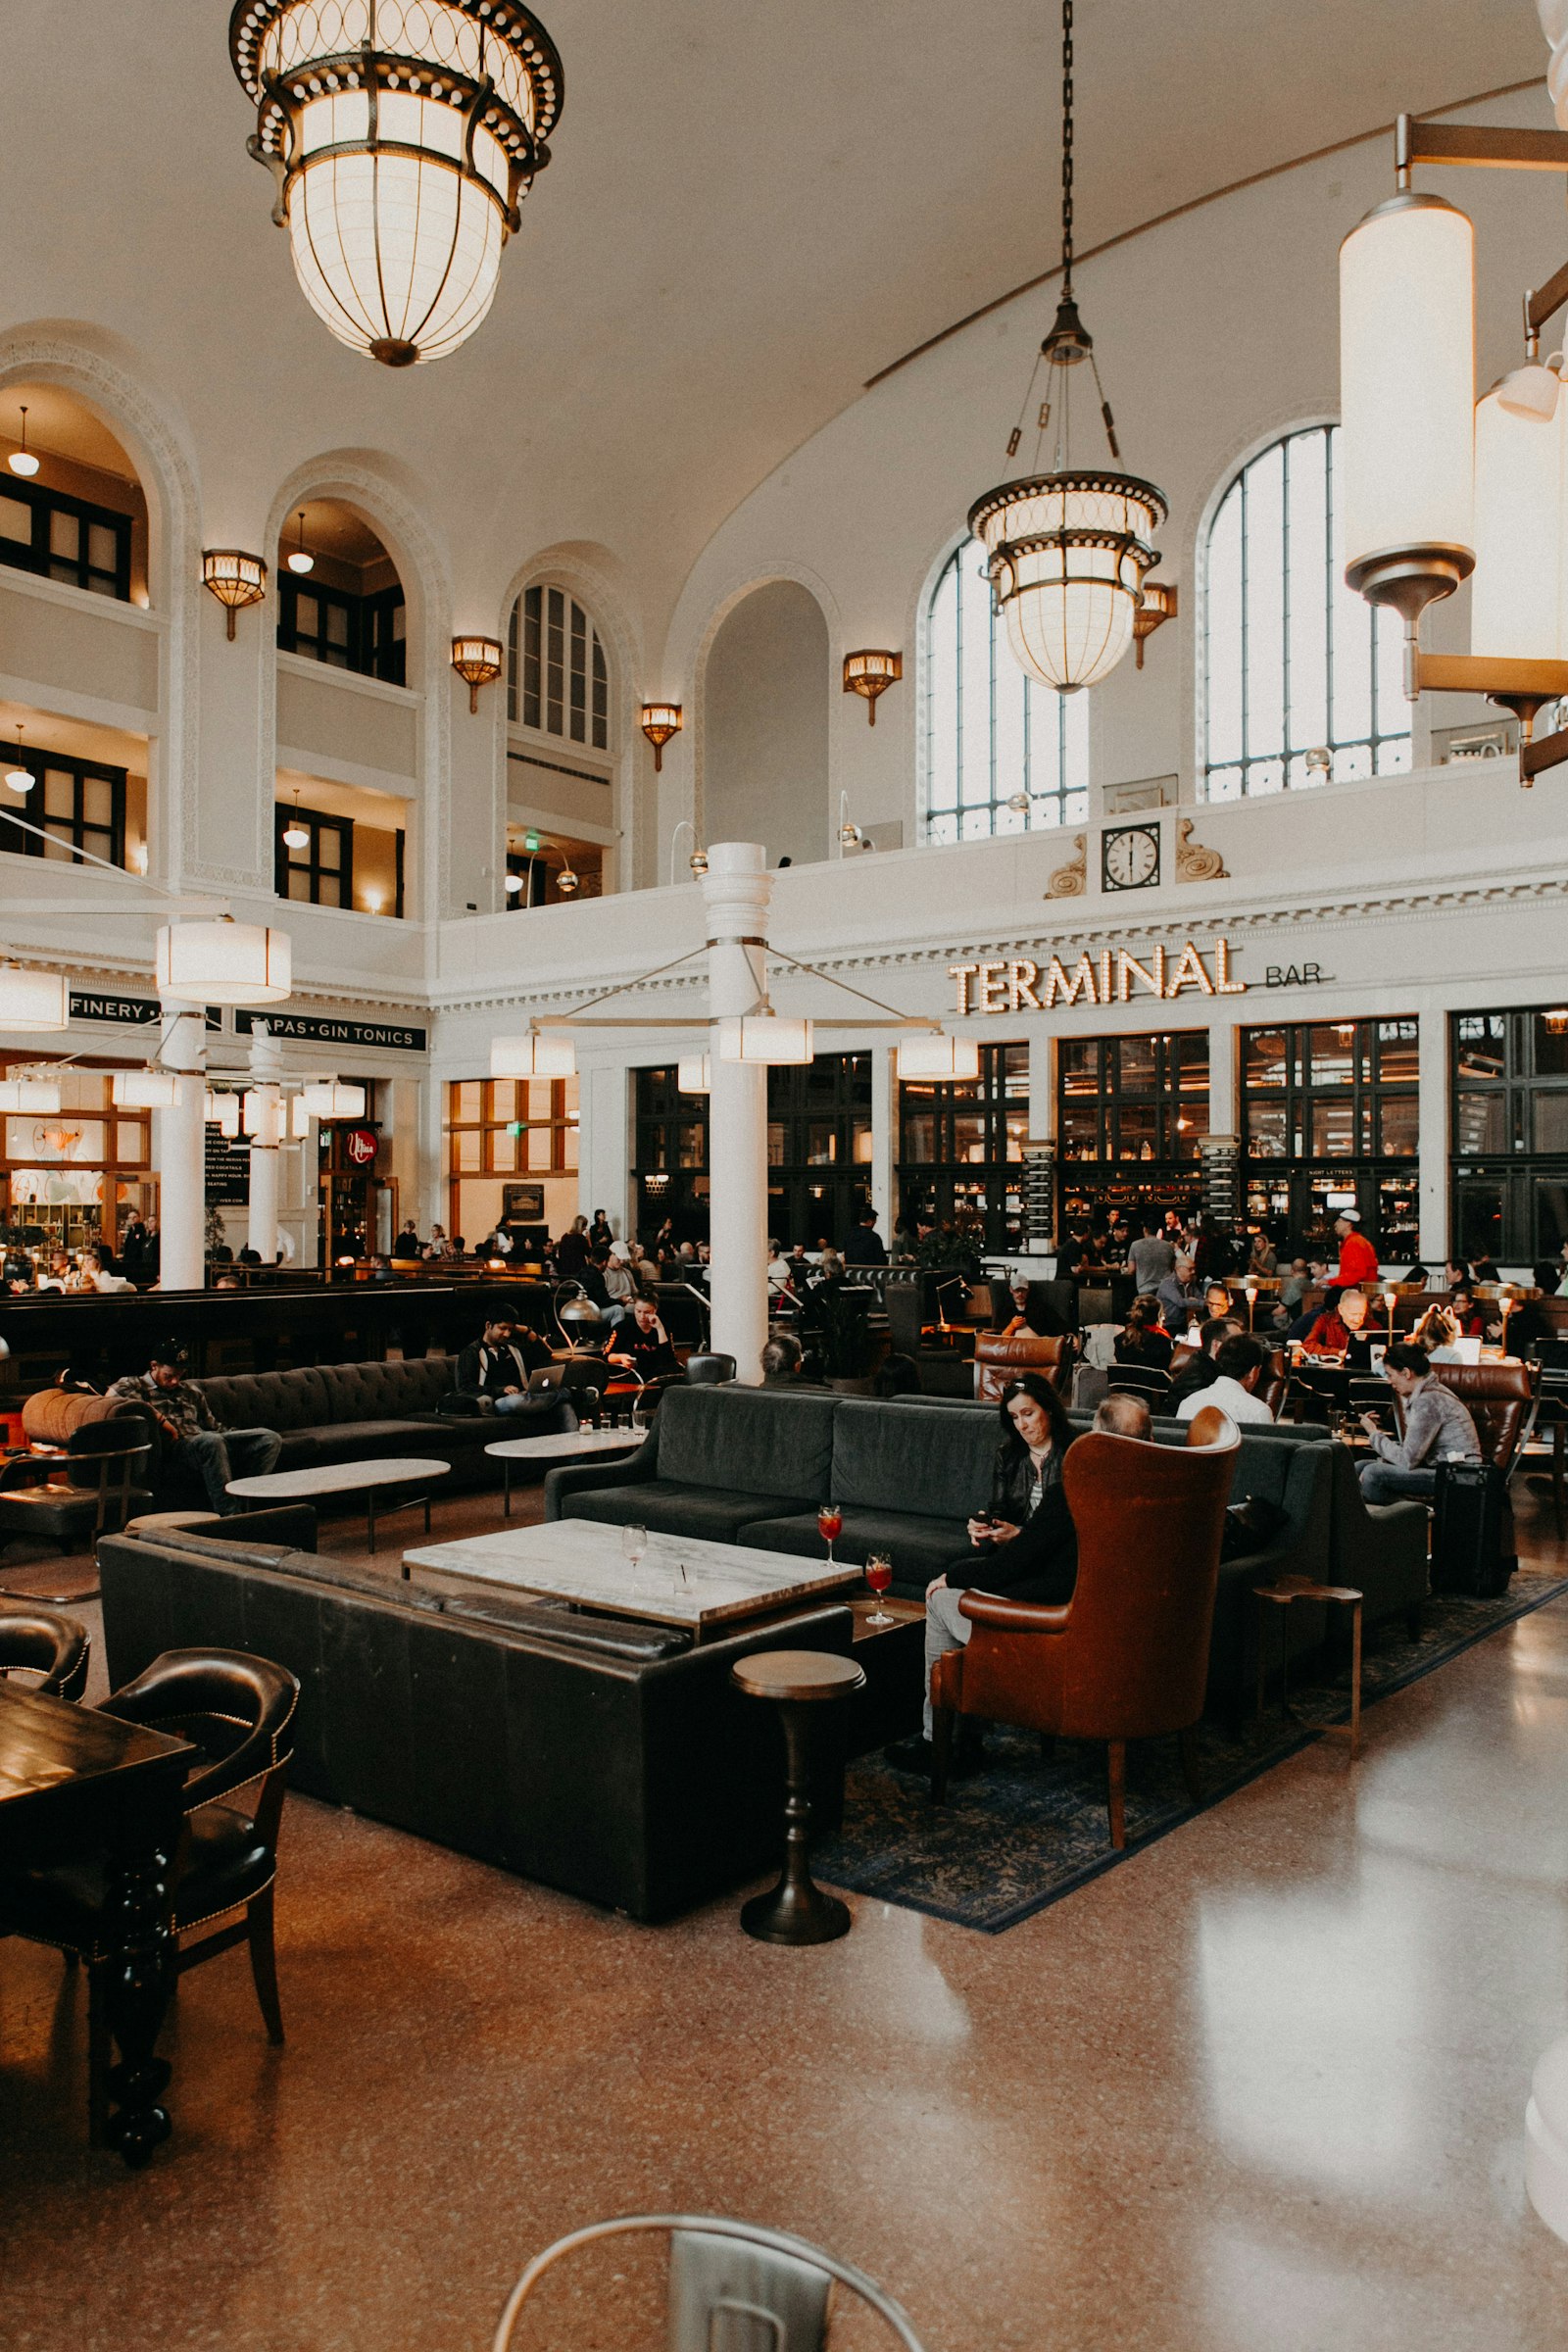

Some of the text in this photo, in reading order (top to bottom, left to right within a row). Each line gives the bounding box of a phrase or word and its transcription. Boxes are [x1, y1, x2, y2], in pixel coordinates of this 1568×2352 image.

[948, 938, 1321, 1015] TERMINAL BAR
[71, 998, 143, 1018] FINERY
[318, 1024, 348, 1039] GIN
[354, 1027, 414, 1045] TONICS
